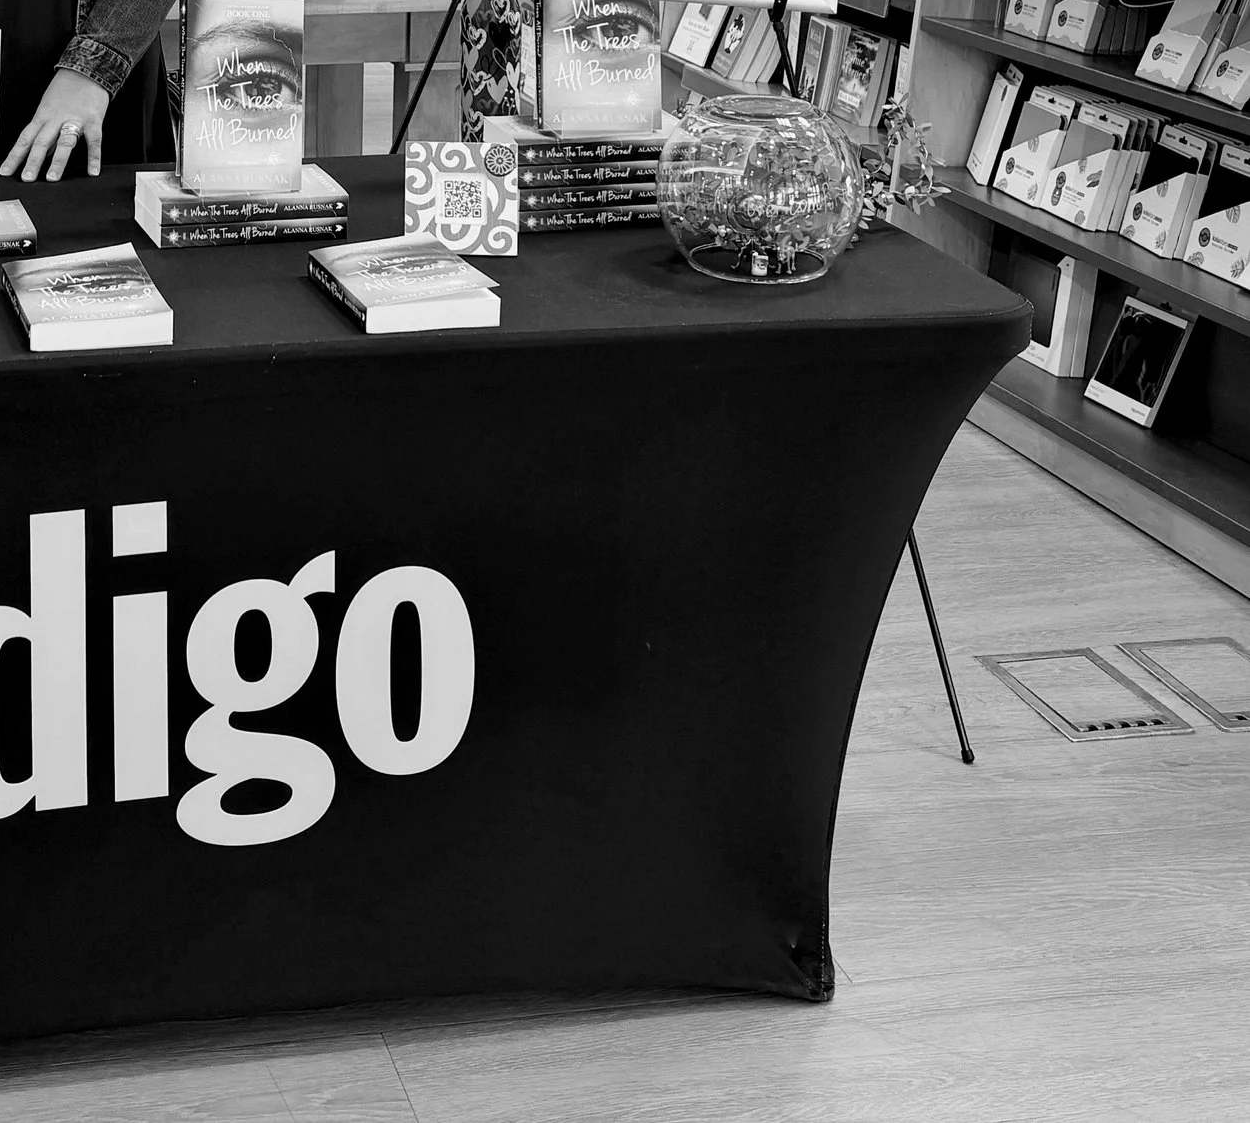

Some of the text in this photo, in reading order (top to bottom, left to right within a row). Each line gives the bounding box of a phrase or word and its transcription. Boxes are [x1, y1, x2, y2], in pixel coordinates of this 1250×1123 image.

[553, 22, 642, 54] The Trees
[216, 48, 265, 78] When
[554, 54, 656, 91] All Burned
[196, 81, 284, 112] The Trees
[196, 113, 297, 151] All Burned
